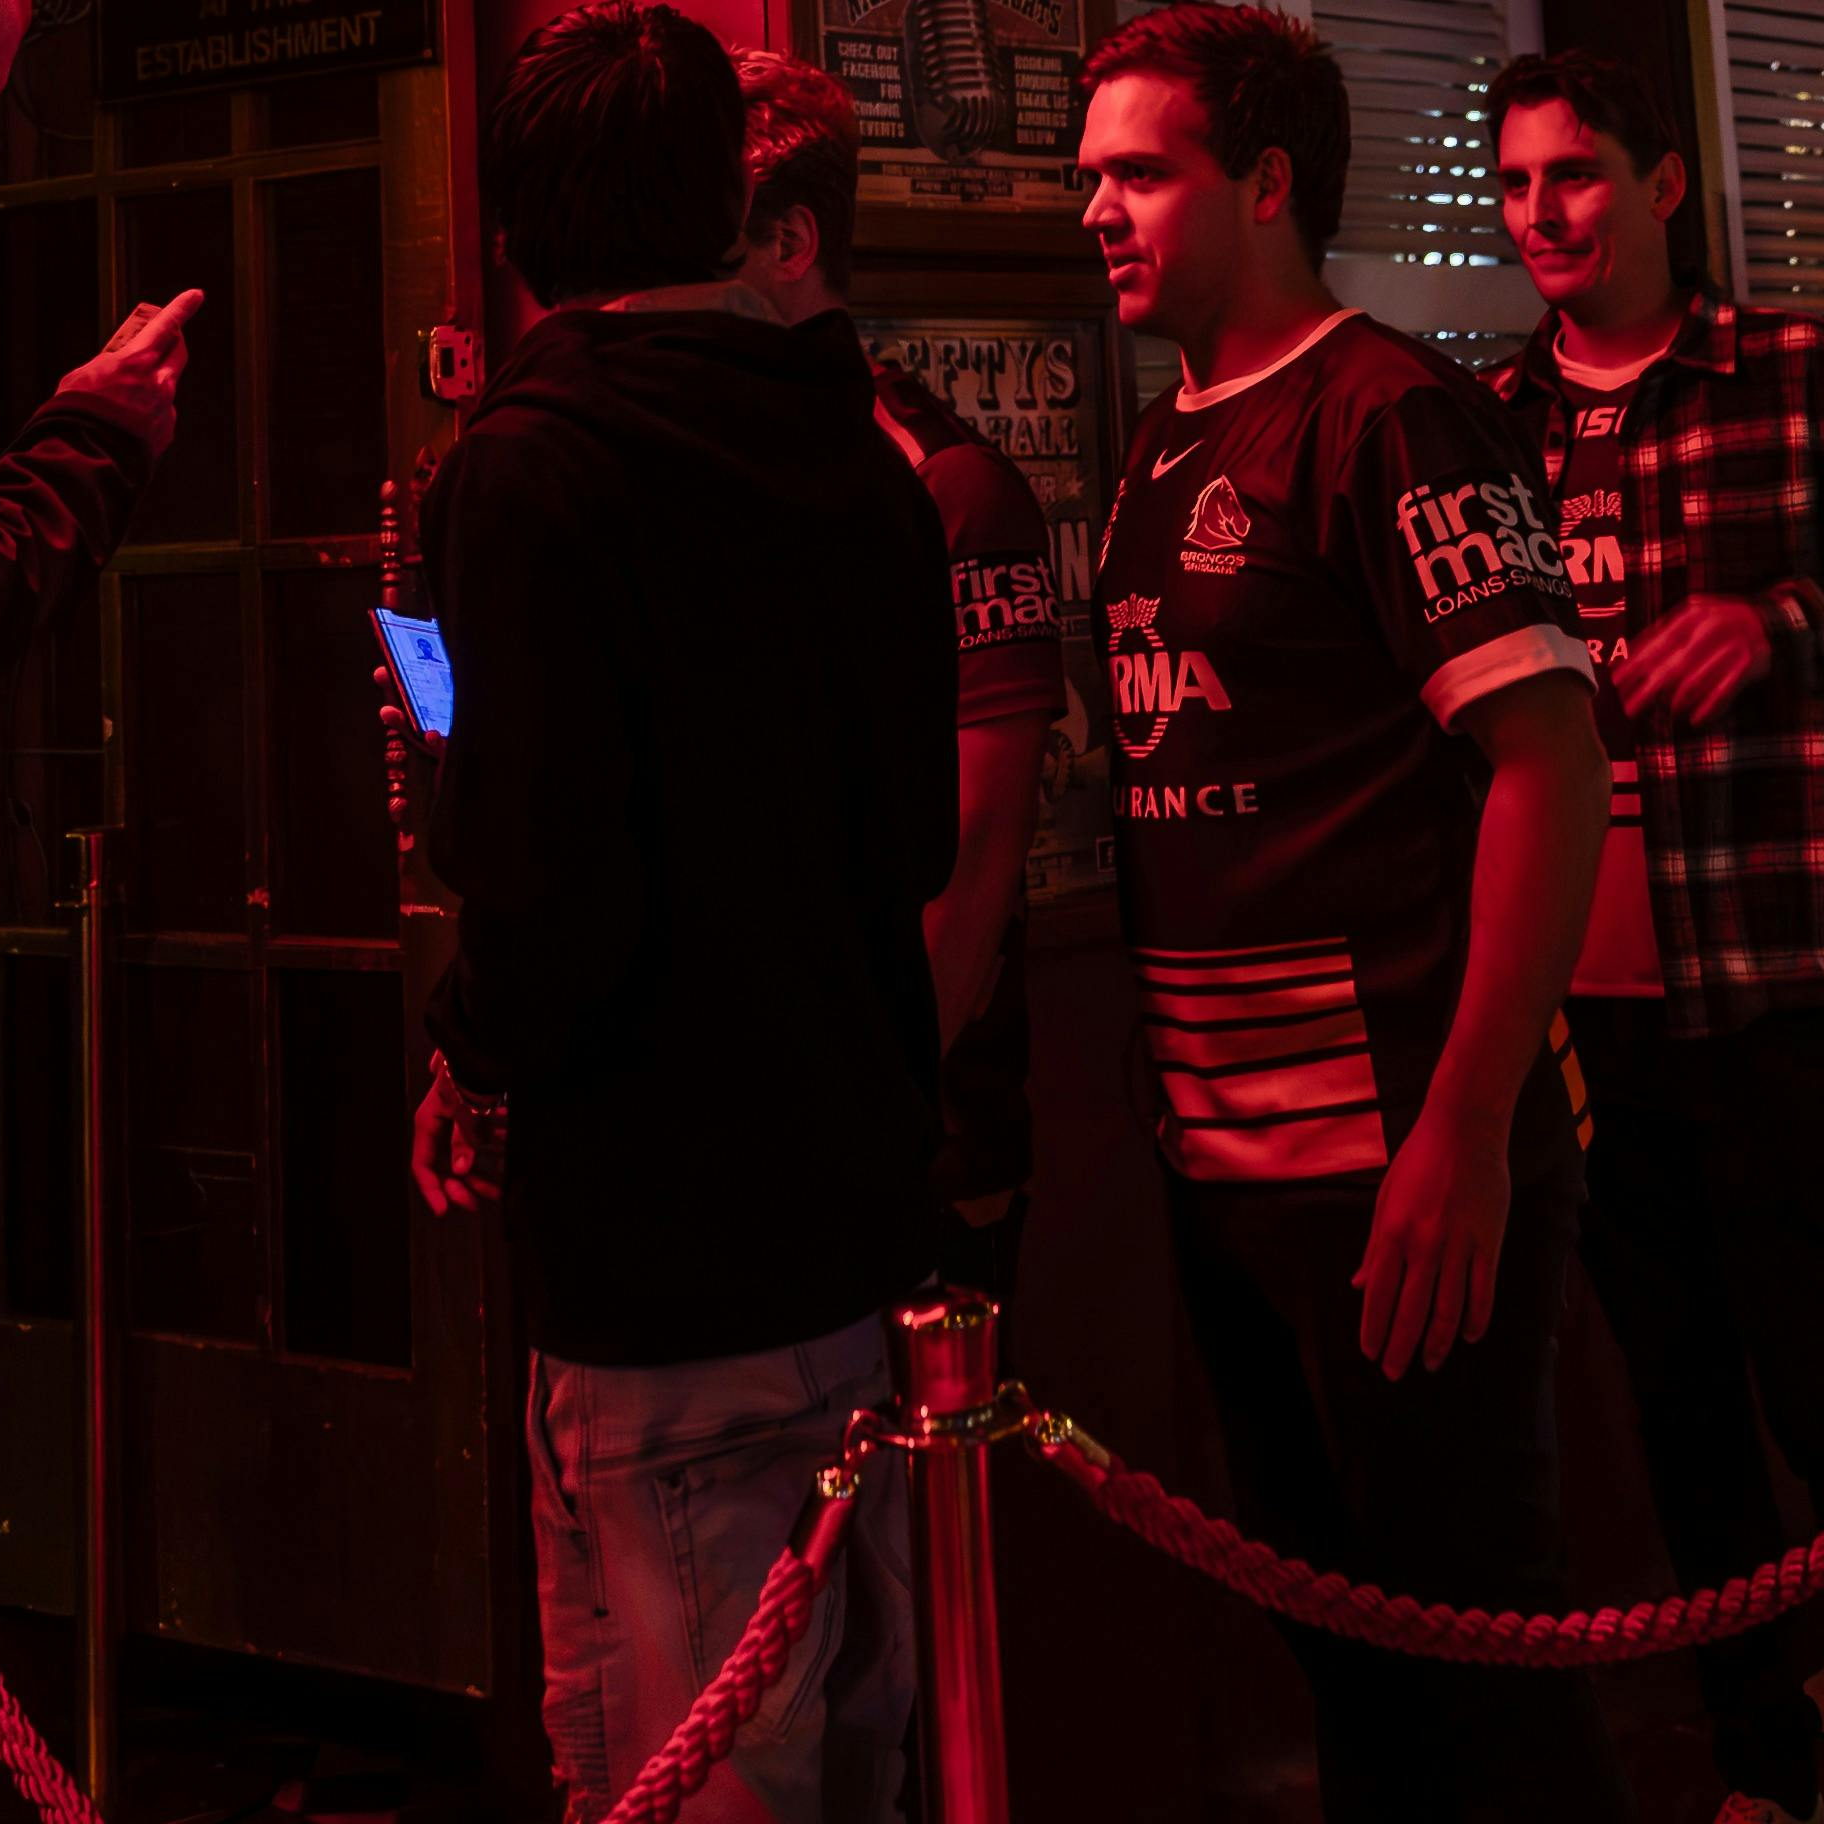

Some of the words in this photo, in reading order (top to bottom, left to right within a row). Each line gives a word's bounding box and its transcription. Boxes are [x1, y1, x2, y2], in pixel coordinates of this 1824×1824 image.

[136, 9, 383, 83] ESTABLISHMENT
[862, 335, 1080, 410] EFTYS
[985, 416, 1080, 458] HALL
[1396, 473, 1544, 557] first
[949, 557, 1054, 603] first
[1179, 551, 1245, 567] BRONCOS
[1412, 527, 1564, 601] mac
